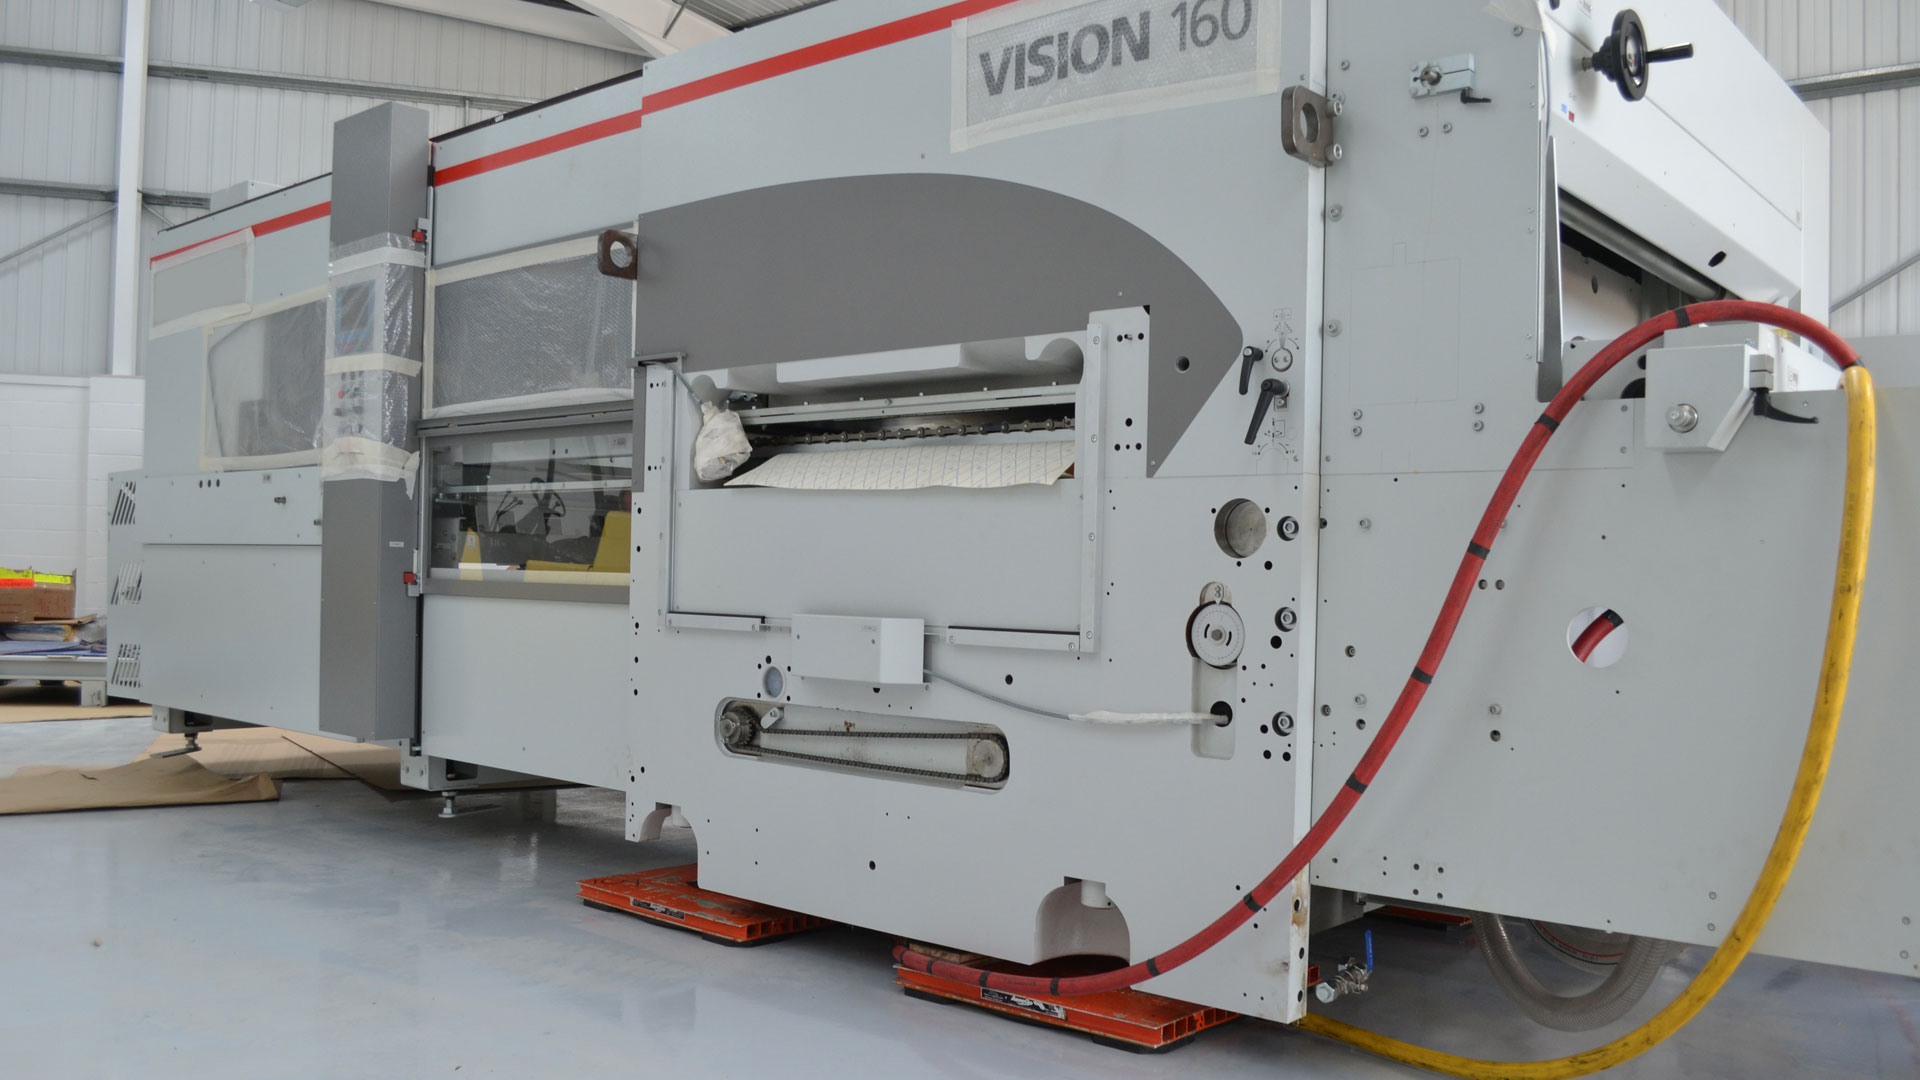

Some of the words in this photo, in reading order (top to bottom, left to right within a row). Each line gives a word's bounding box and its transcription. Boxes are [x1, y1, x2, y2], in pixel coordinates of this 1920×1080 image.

[979, 11, 1151, 97] VISION
[1171, 0, 1253, 52] 160
[1215, 585, 1222, 598] 3
